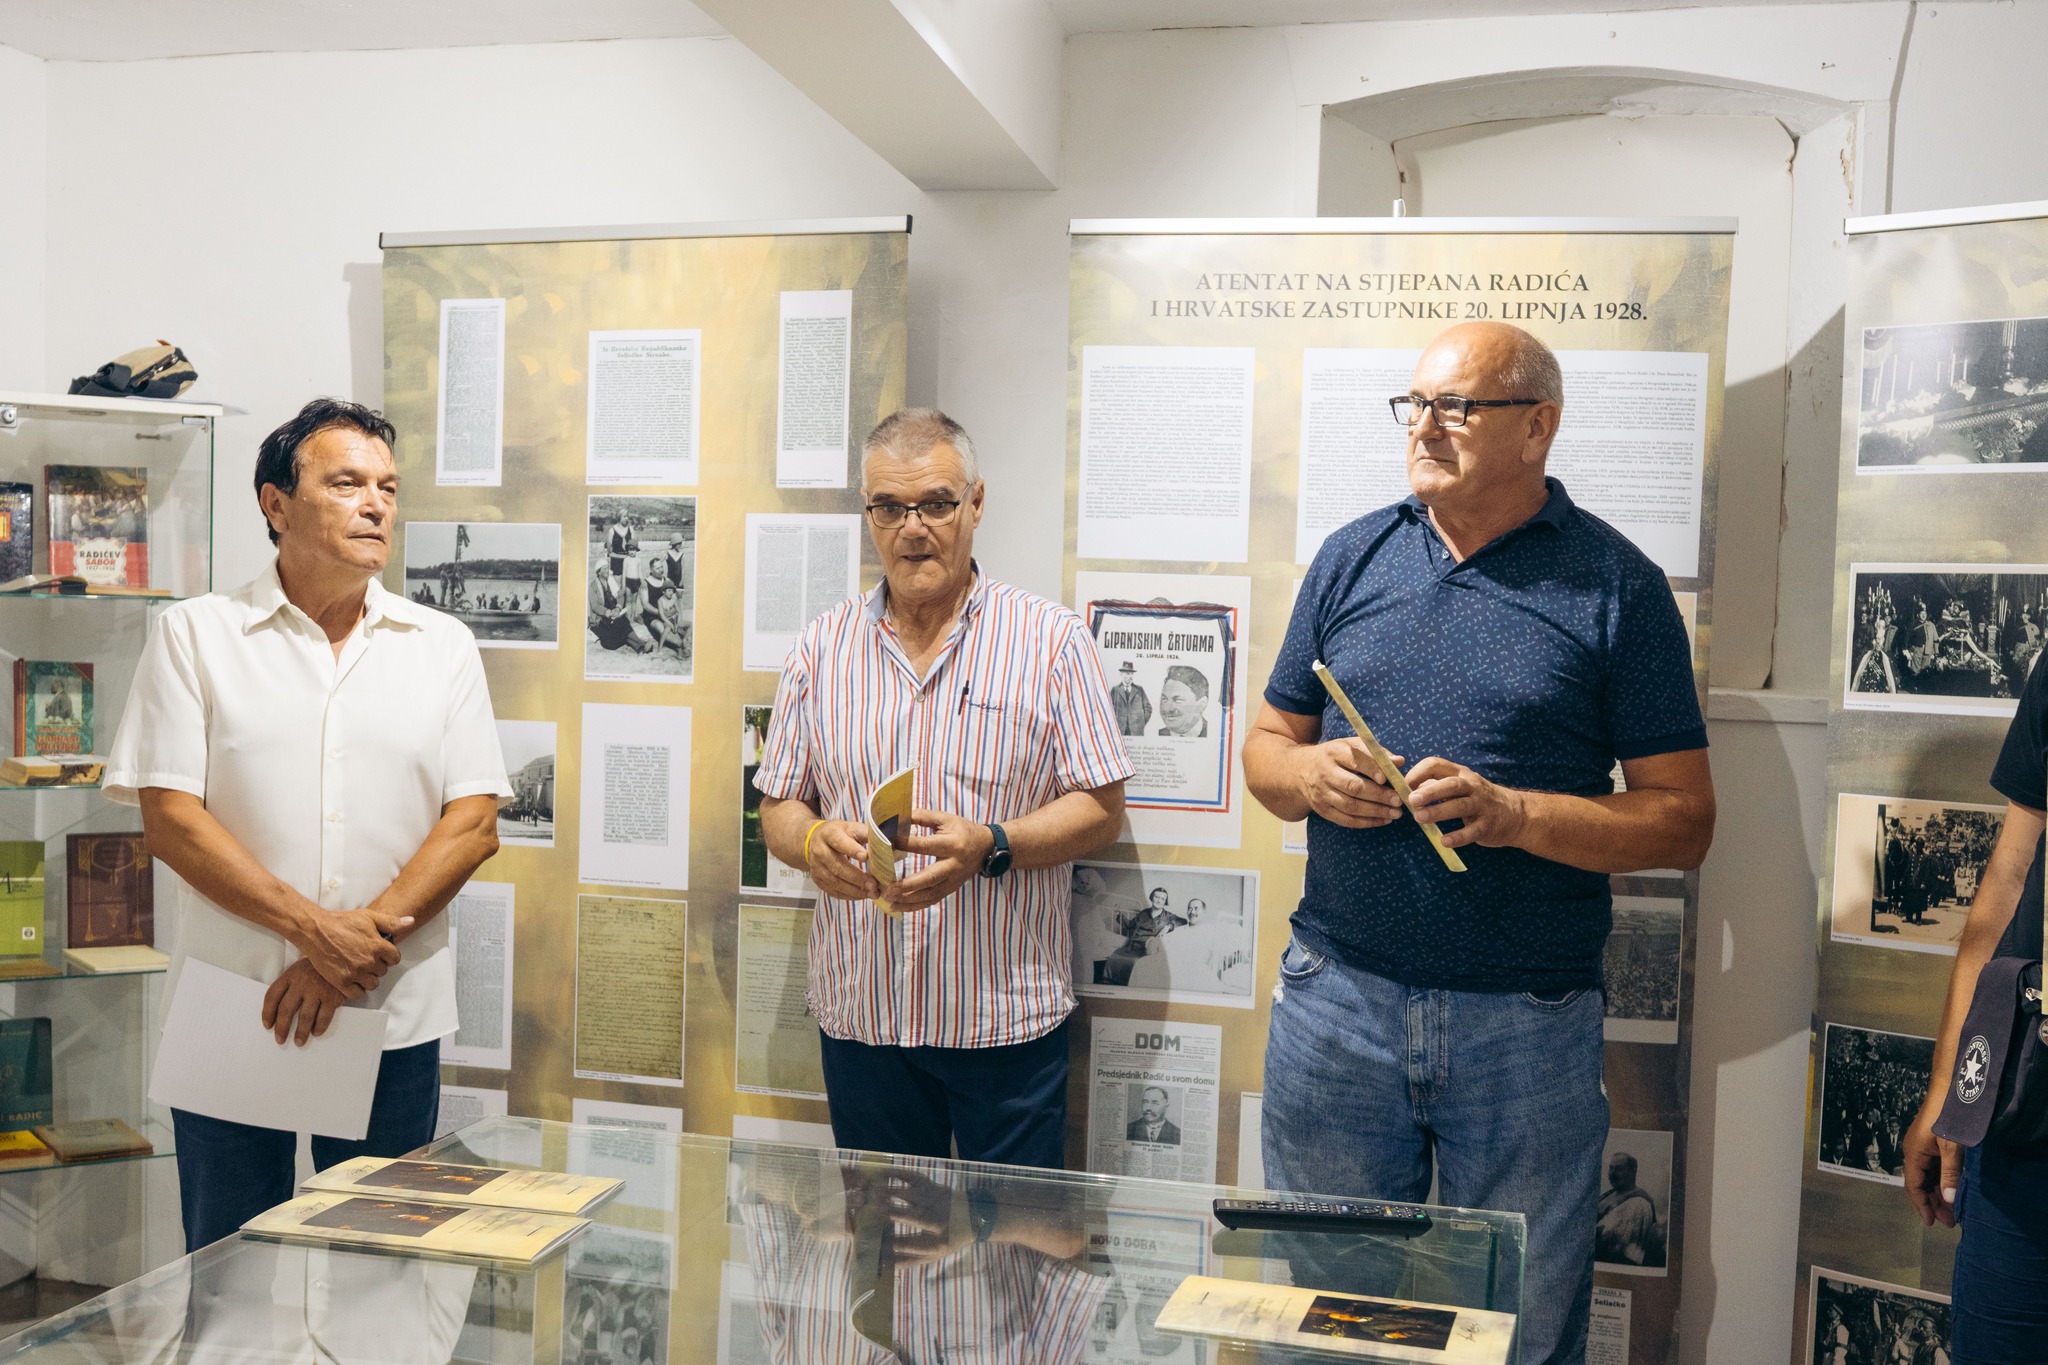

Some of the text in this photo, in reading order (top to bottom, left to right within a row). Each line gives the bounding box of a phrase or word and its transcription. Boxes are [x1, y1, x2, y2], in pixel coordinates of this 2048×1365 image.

[1195, 268, 1590, 295] ATENTAT NA STJEPANA RADIĆA
[1150, 300, 1648, 325] I HRVATSKE ZASTUPNIKE 20. LIPNJA 1928.
[79, 549, 121, 558] RADIĆEV
[1104, 631, 1162, 651] LIPANJSKIM
[1135, 1032, 1181, 1052] DOM
[1097, 1069, 1142, 1080] Predsjednik
[1143, 1071, 1164, 1081] Radić
[1193, 1076, 1215, 1086] domu
